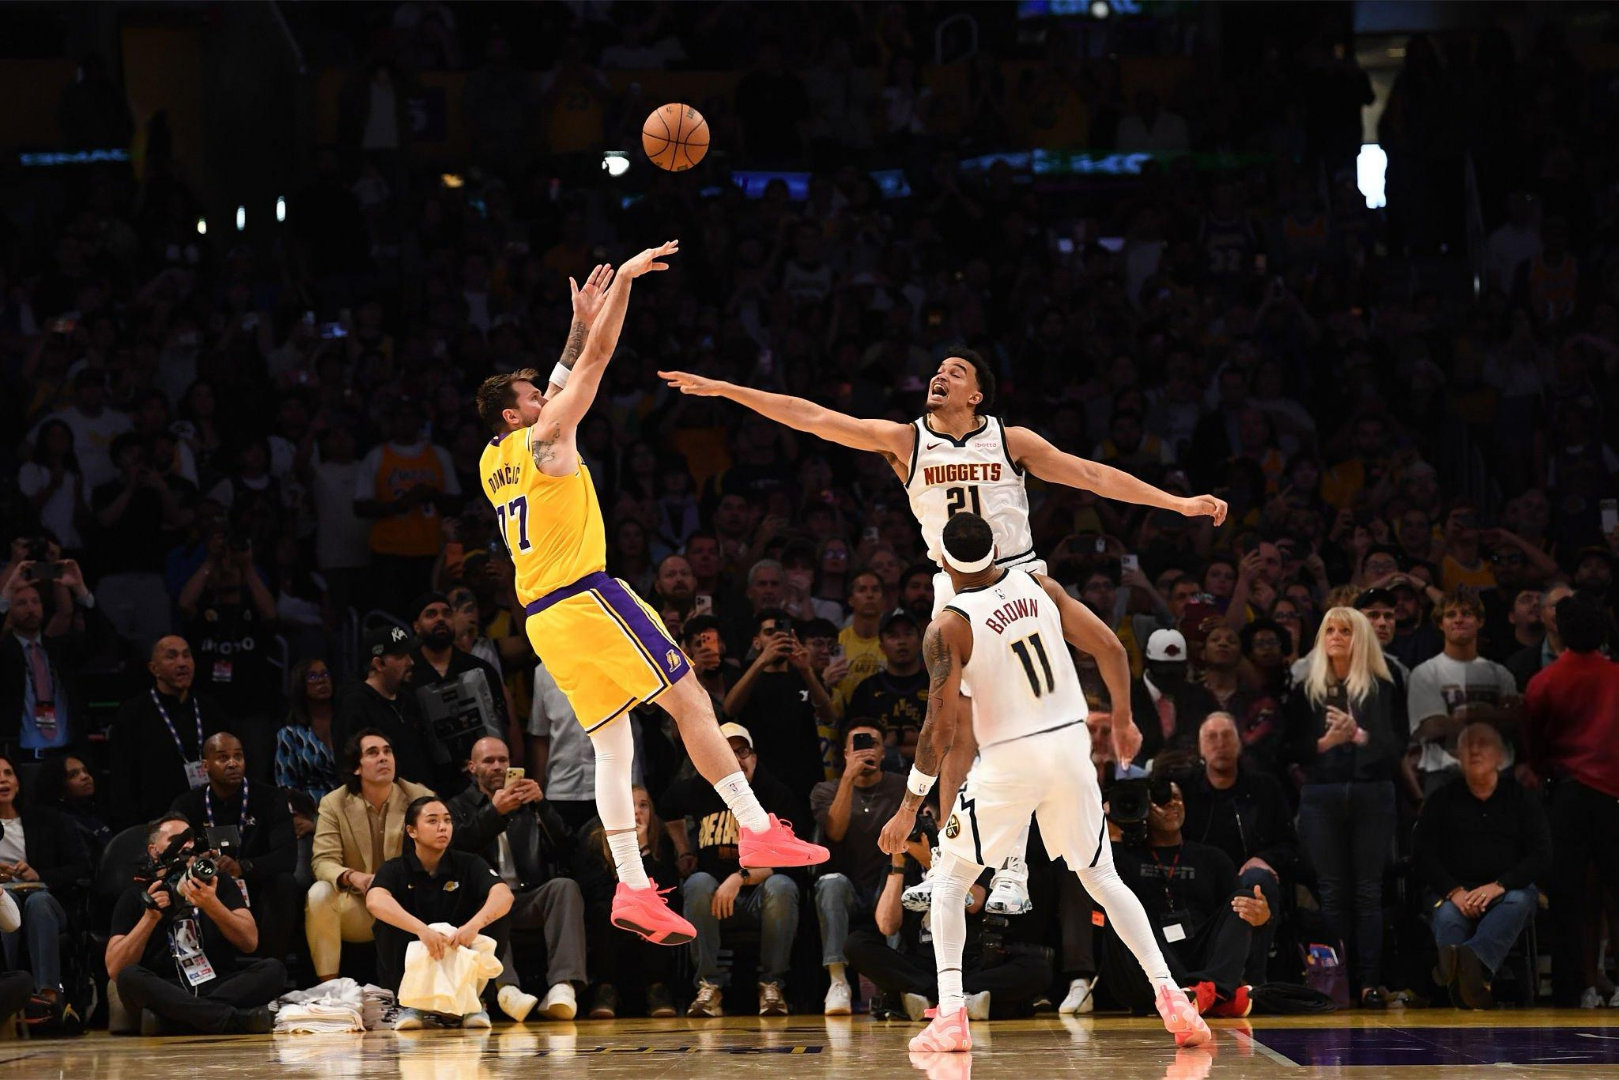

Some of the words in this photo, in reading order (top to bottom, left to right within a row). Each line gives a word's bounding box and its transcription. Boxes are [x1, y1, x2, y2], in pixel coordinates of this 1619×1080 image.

[488, 463, 521, 494] DONČIĆ
[923, 463, 1001, 486] NUGGETS
[946, 485, 982, 519] 21
[497, 496, 531, 556] 77
[986, 598, 1039, 635] BROWN
[1011, 632, 1055, 698] 11
